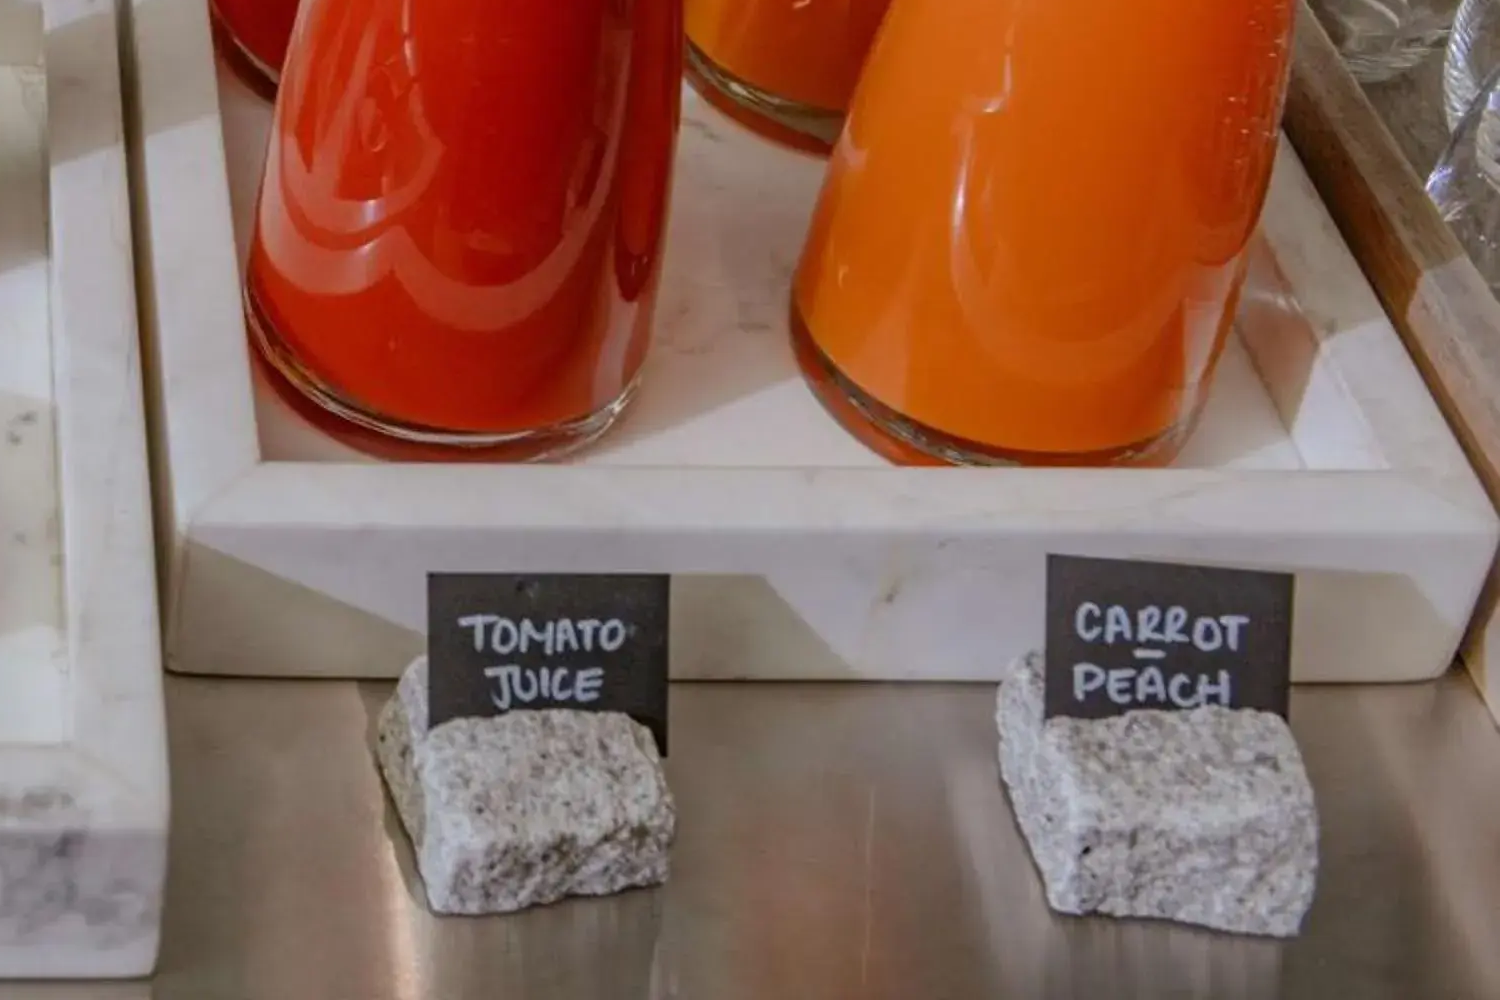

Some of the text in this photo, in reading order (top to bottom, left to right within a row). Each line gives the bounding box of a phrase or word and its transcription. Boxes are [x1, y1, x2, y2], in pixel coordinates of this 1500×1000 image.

[457, 613, 627, 655] TOMATO
[1074, 601, 1250, 652] CARROT
[484, 664, 604, 709] JUICE
[1072, 662, 1231, 708] PEACH
